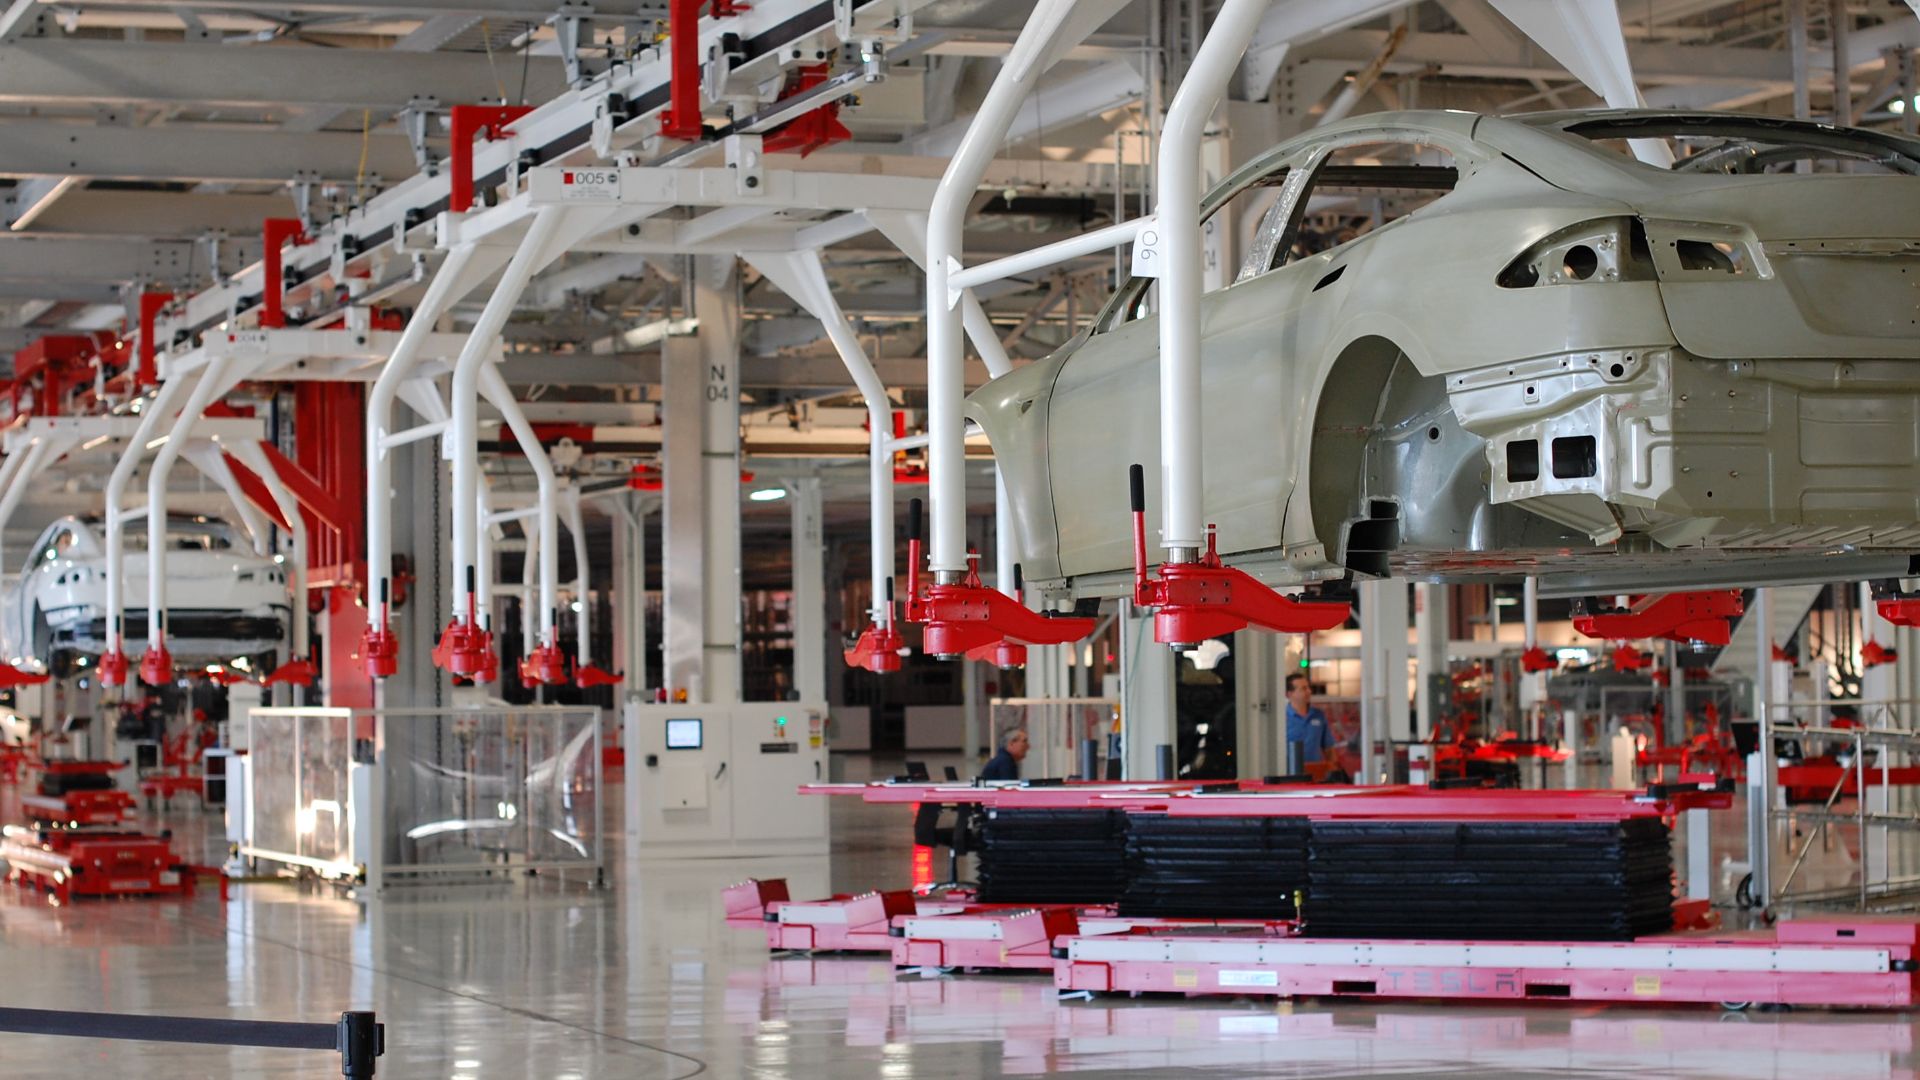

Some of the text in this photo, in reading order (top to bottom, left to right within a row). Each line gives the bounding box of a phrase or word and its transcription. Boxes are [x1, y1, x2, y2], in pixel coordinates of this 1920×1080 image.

[576, 172, 604, 185] 005
[711, 365, 725, 381] N
[706, 384, 728, 402] 04
[1385, 972, 1515, 992] TESLA
